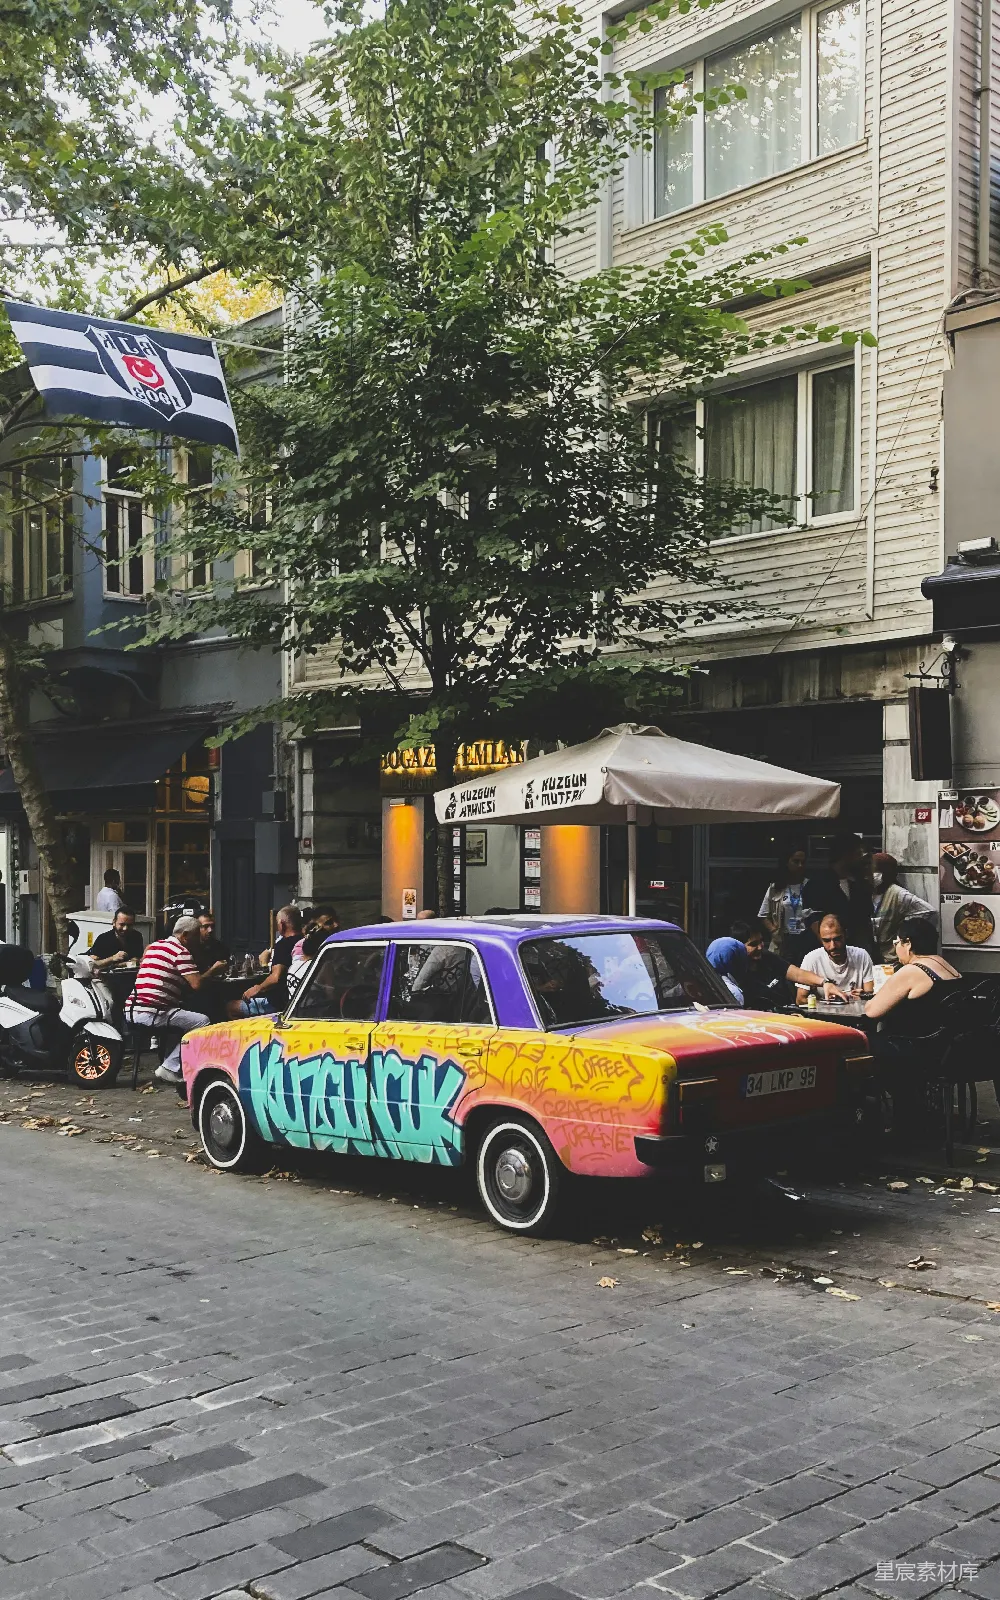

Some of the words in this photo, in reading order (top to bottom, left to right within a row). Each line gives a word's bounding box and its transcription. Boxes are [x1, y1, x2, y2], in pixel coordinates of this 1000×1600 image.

[541, 773, 587, 792] KUZGUN
[460, 786, 497, 803] KUZGUN
[573, 1050, 629, 1084] COFFEE
[746, 1075, 763, 1095] 34
[770, 1071, 794, 1092] LKP
[800, 1067, 816, 1086] 95
